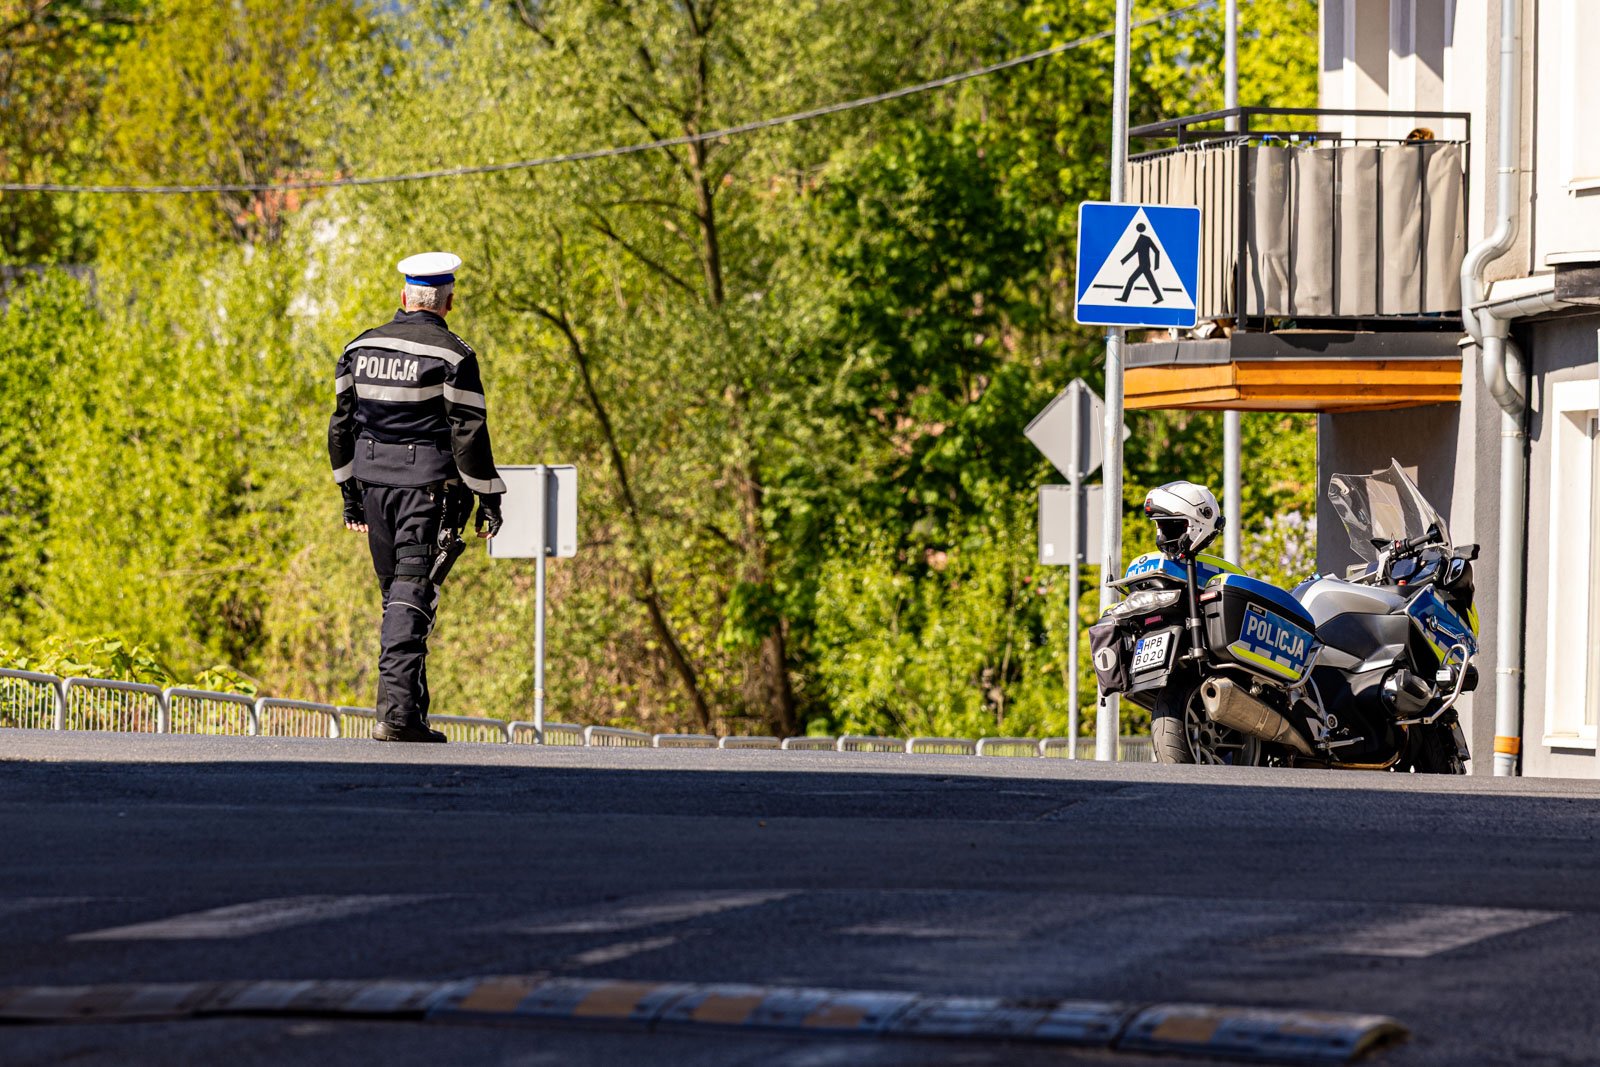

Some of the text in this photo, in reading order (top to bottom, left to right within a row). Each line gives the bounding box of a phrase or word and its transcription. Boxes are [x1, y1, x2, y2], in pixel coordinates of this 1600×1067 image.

[355, 355, 419, 382] POLICJA
[1144, 636, 1163, 651] HPB
[1246, 615, 1304, 661] POLICJA
[1135, 649, 1164, 666] B020
